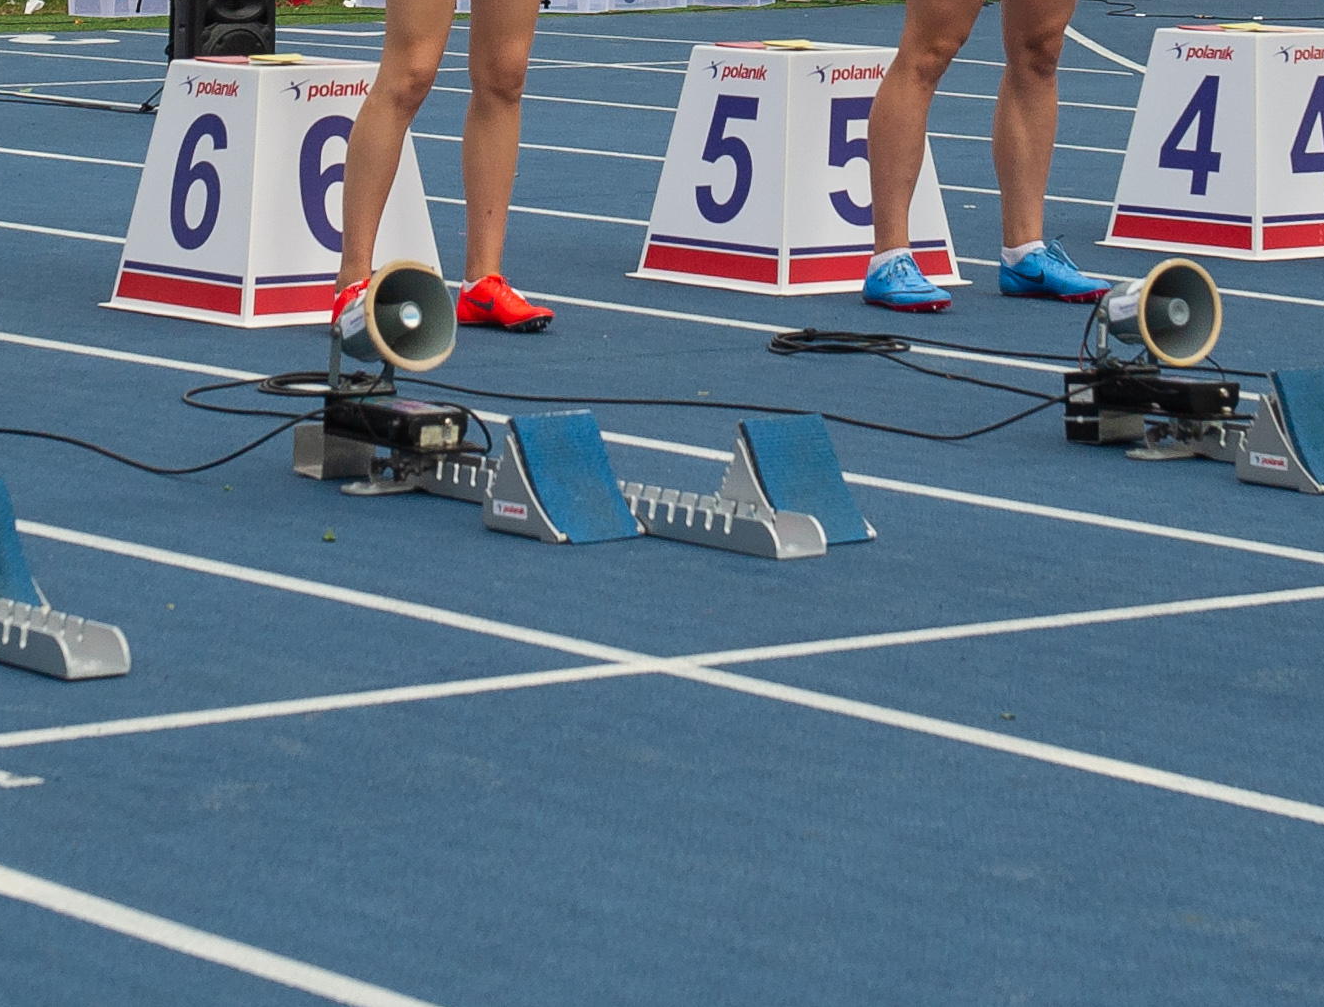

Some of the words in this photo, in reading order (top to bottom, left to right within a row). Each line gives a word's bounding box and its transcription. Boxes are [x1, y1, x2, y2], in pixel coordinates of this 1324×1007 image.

[195, 78, 240, 98] polanik
[721, 62, 767, 82] polanik
[831, 62, 886, 85] polanik
[1185, 43, 1234, 61] polanik
[307, 78, 369, 101] polanik
[695, 94, 760, 224] 5
[828, 97, 876, 227] 5
[1159, 75, 1221, 196] 4
[170, 113, 228, 251] 6
[299, 115, 356, 253] 6
